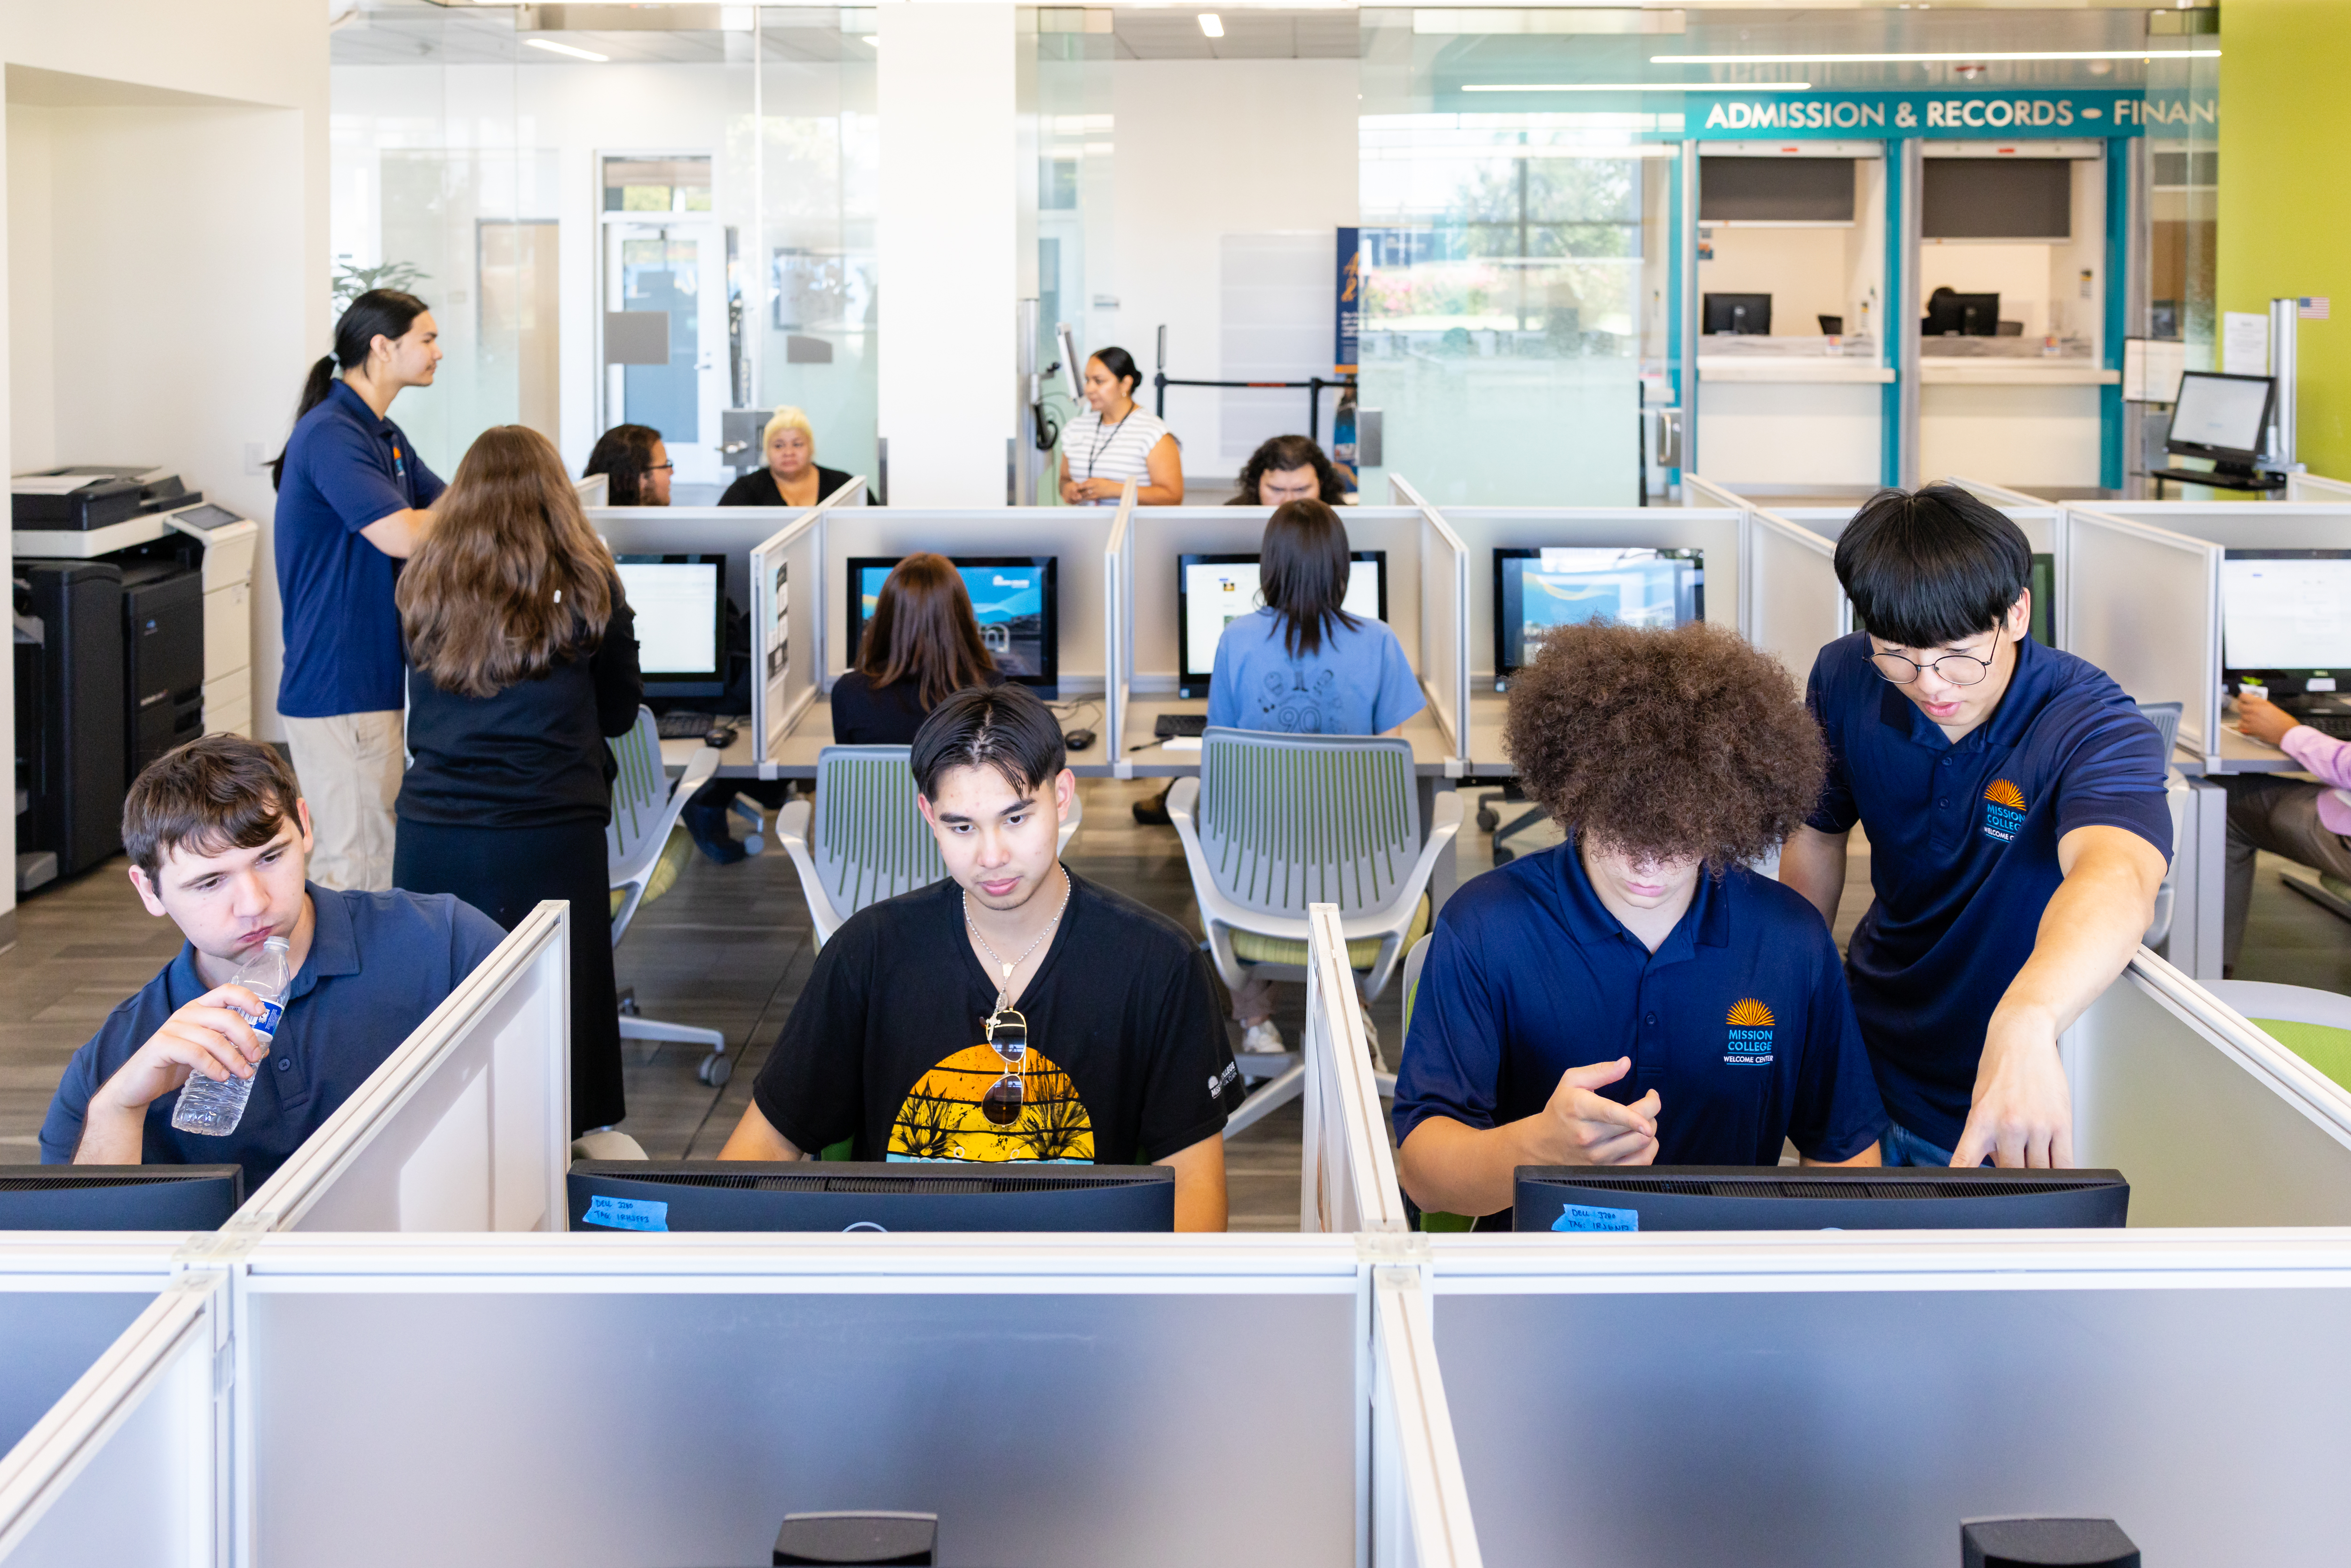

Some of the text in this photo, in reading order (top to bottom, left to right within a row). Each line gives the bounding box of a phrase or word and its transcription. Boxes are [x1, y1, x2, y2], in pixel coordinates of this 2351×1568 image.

[1705, 99, 2220, 129] ADMISSION & RECORDS FINAN
[1987, 804, 2026, 823] MISSION
[1987, 814, 2021, 831] COLLEG
[1984, 827, 2009, 840] WELCOME
[1728, 1030, 1773, 1040] MISSION
[1728, 1041, 1772, 1051] COLLEGE
